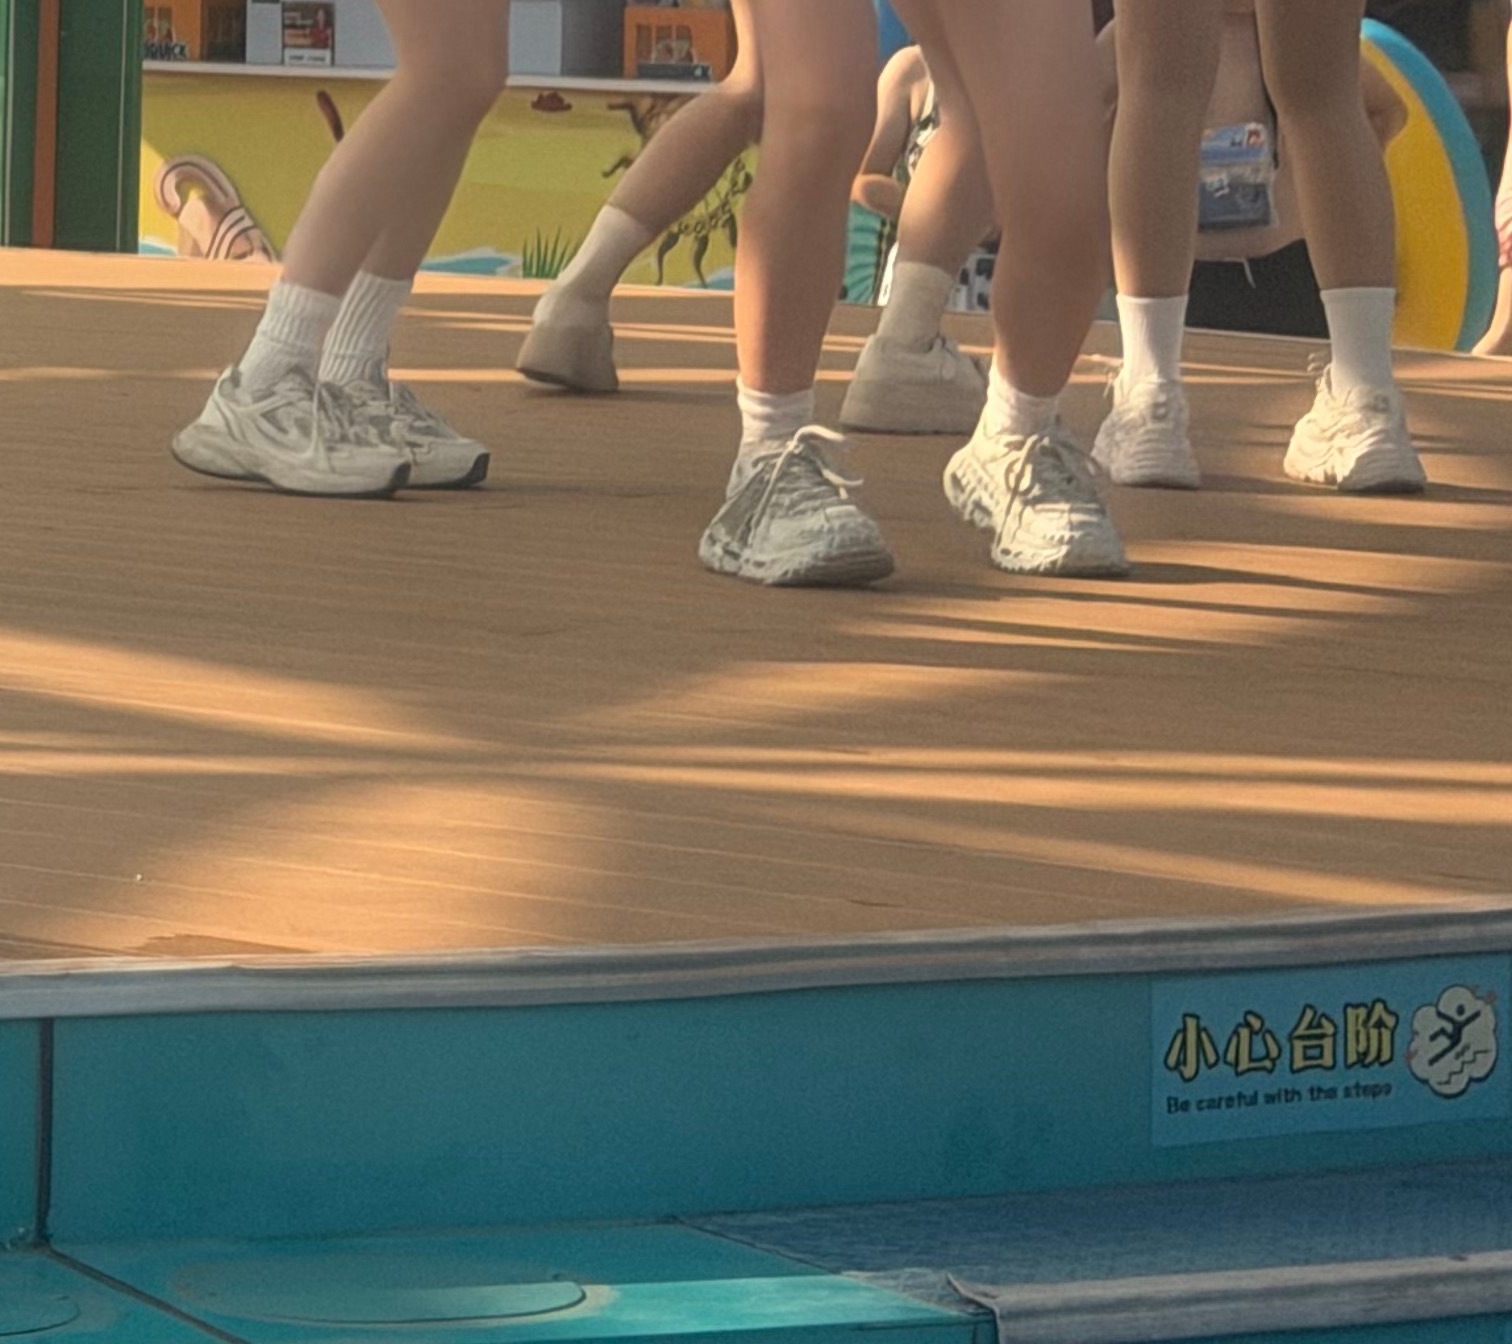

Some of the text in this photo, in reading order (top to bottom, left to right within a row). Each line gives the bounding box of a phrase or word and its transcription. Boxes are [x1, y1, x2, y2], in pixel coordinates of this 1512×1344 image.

[1164, 998, 1399, 1082] 小心台阶
[1166, 1081, 1393, 1113] Be careful with the steps
